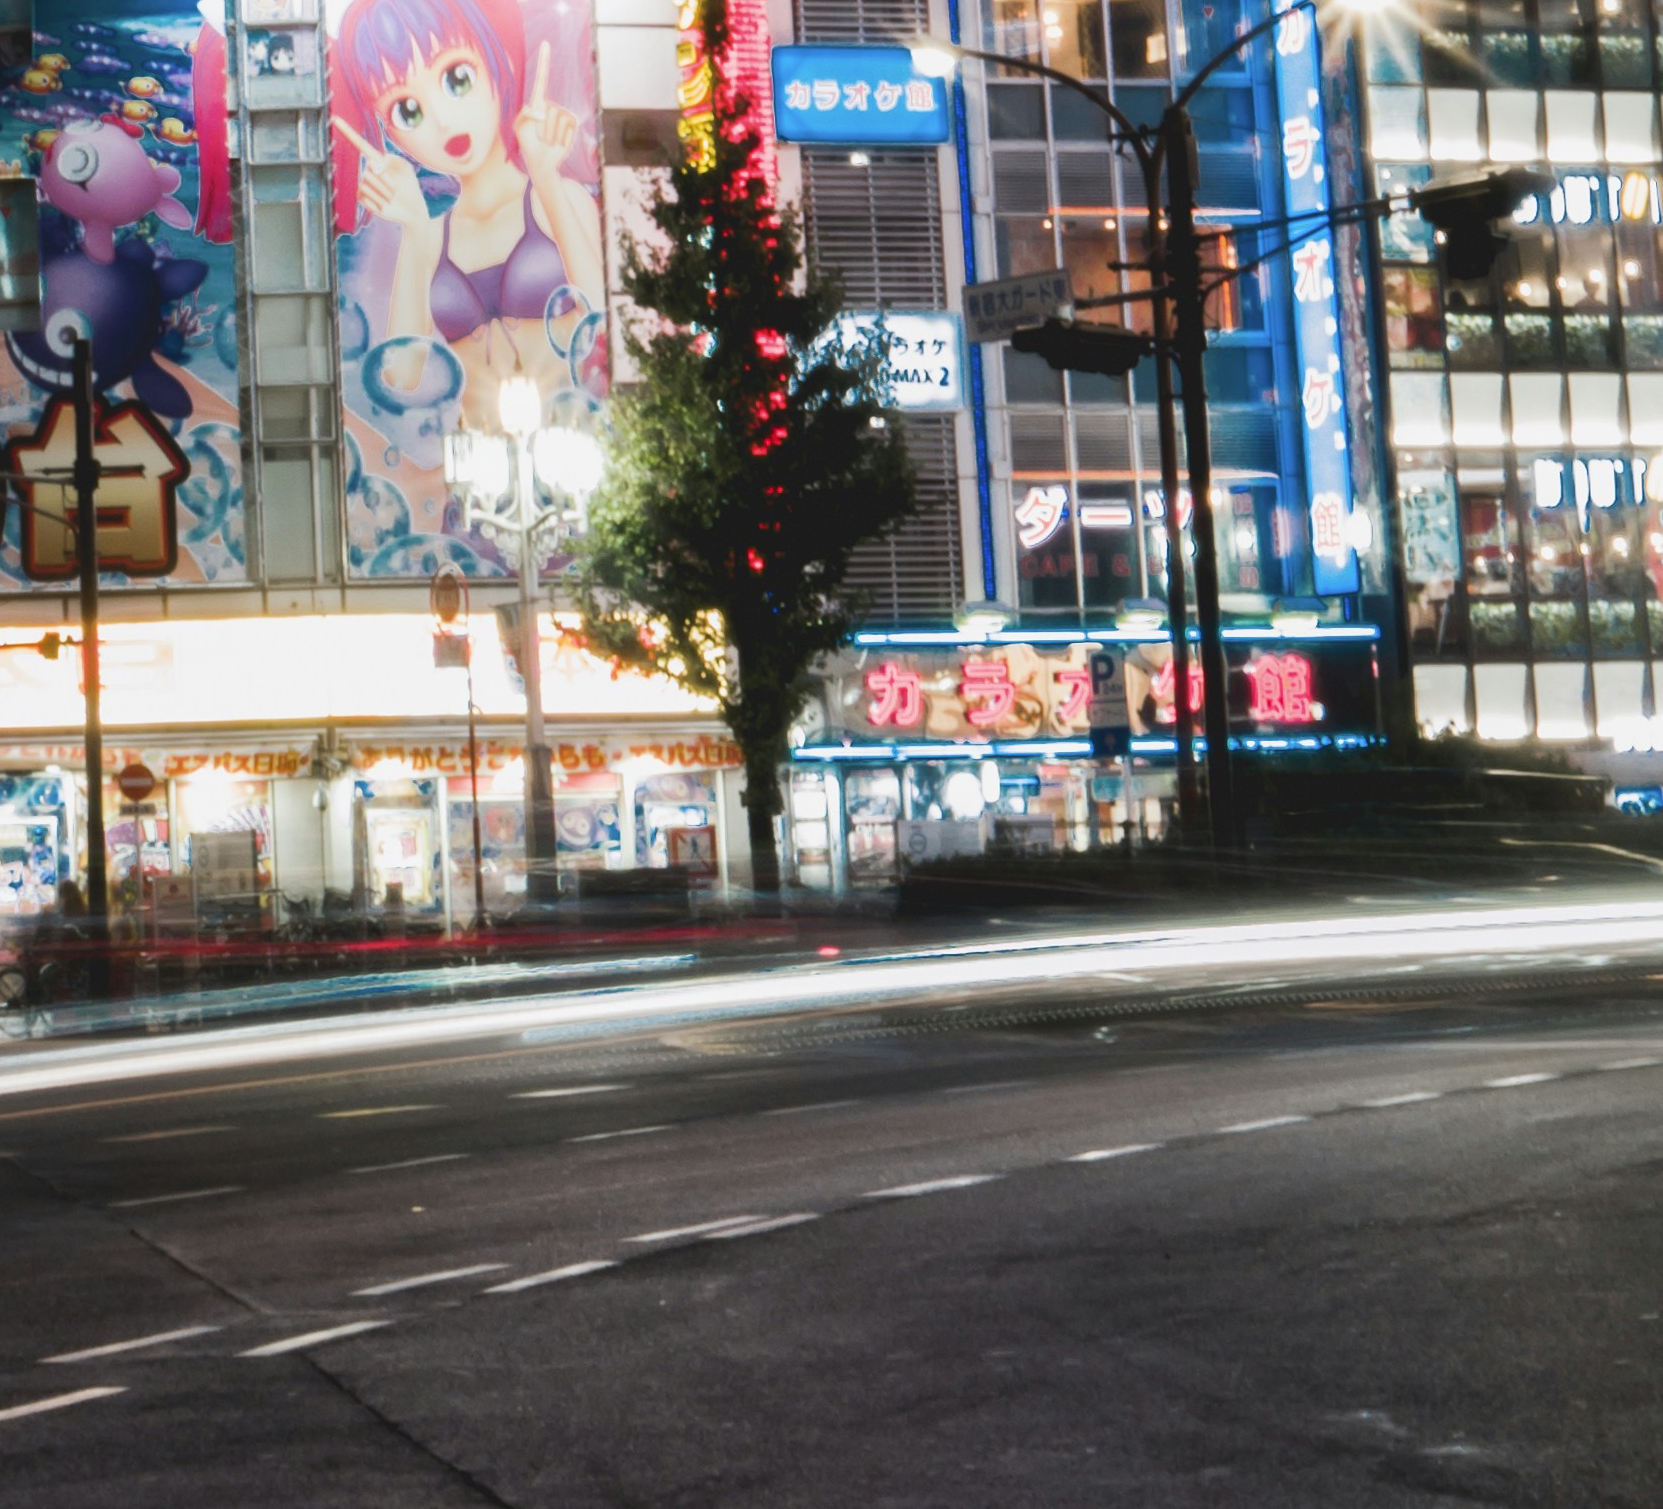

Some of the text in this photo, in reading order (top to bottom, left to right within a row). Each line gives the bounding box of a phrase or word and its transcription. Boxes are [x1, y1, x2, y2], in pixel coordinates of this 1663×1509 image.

[784, 78, 935, 113] カラオケ館
